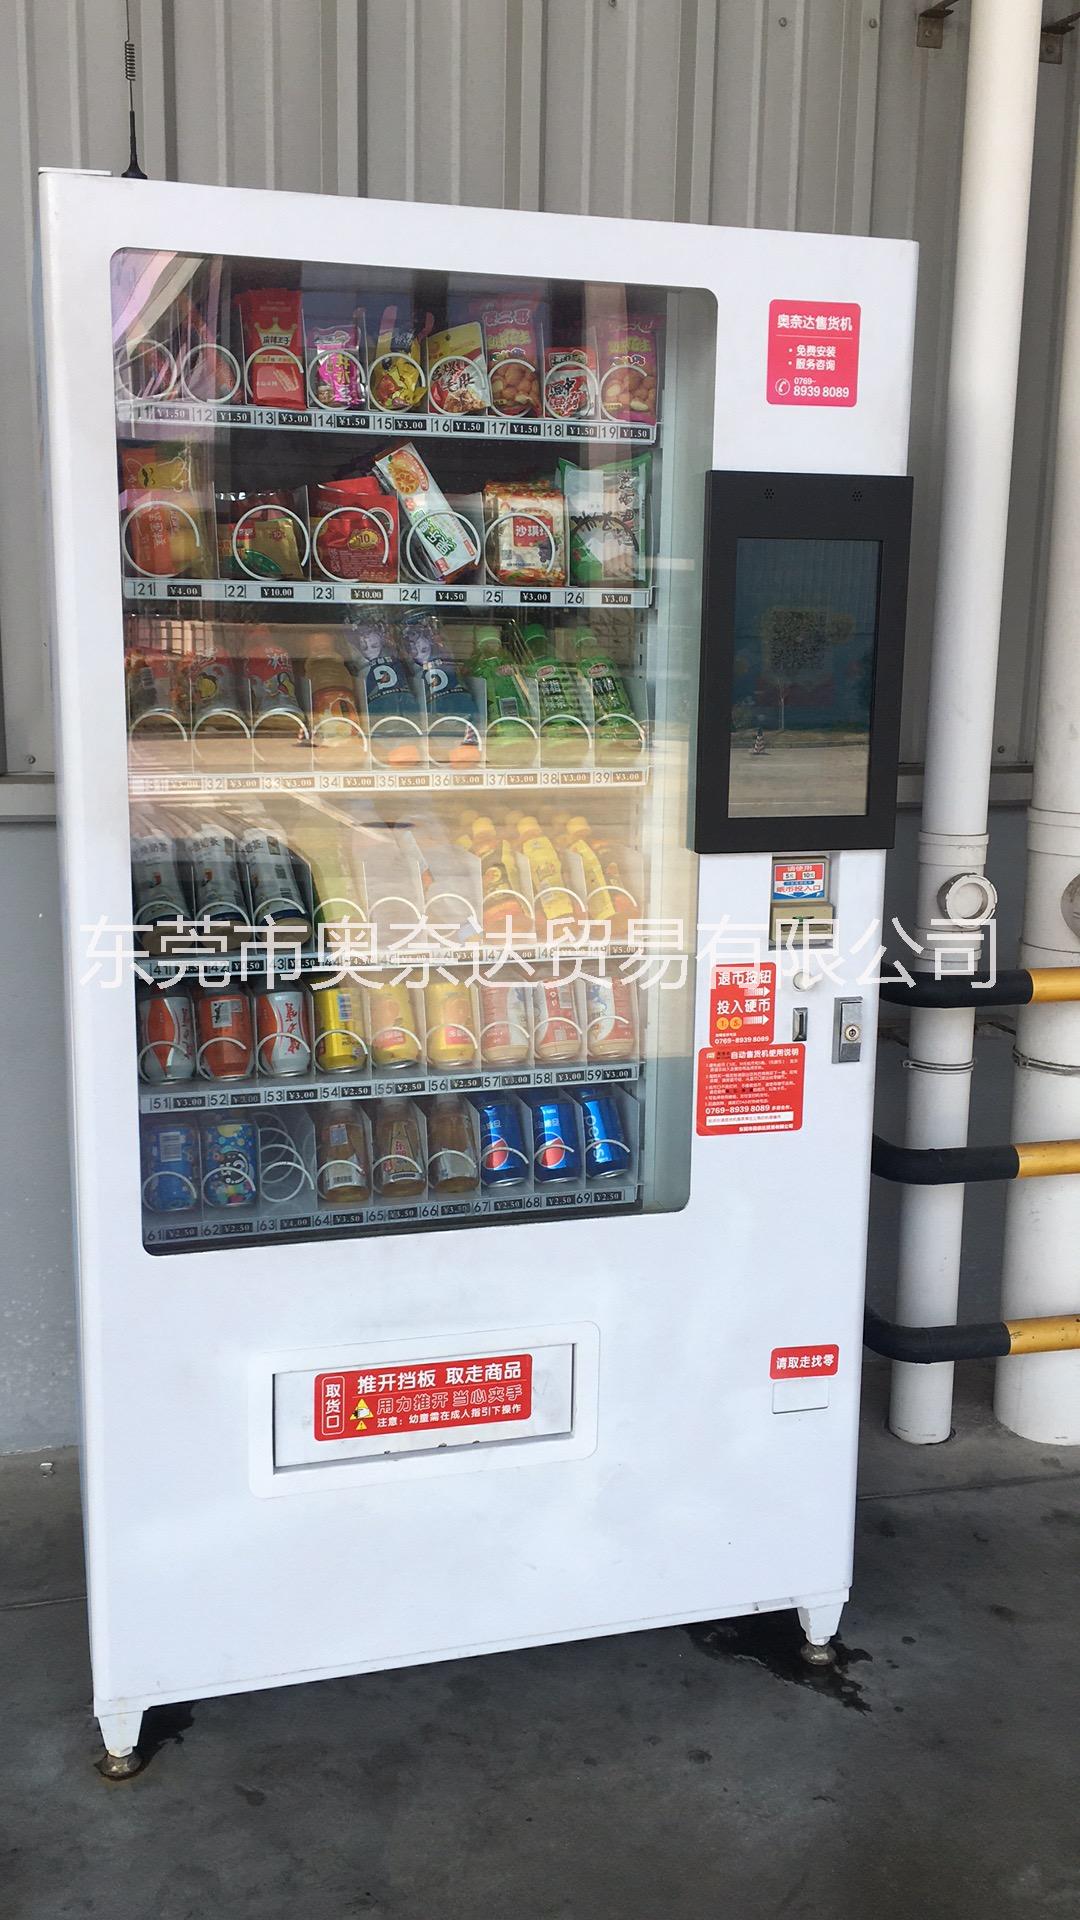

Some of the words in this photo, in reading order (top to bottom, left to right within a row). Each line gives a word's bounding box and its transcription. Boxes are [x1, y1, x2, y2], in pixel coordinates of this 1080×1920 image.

[778, 314, 852, 332] 奥奈达售货机
[796, 345, 836, 358] 免费安装
[796, 358, 836, 371] 服务咨询
[793, 386, 821, 396] 8939
[822, 387, 850, 398] 8089
[196, 408, 212, 421] 12
[220, 412, 248, 421] ¥1.50
[258, 412, 274, 424] 13
[282, 414, 308, 423] ¥3.00
[318, 414, 334, 426] 14
[339, 416, 366, 426] ¥1.50
[378, 417, 392, 430] 15
[398, 421, 423, 430] ¥3.00
[434, 420, 450, 432] 16
[456, 422, 480, 431] ¥1.50
[492, 422, 506, 435] 17
[512, 424, 538, 434] ¥1.50
[547, 425, 562, 437] 18
[570, 426, 594, 436] ¥1.50
[602, 426, 616, 438] 19
[622, 429, 648, 438] ¥1.50
[138, 582, 154, 596] 21
[170, 586, 198, 596] ¥4.00
[228, 584, 245, 597] 22
[264, 587, 292, 597] ¥10.00
[316, 586, 332, 599] 23
[354, 589, 382, 599] ¥10.00
[402, 589, 418, 601] 24
[438, 592, 464, 601] ¥4.50
[486, 590, 500, 602] 25
[523, 592, 548, 602] ¥3.00
[568, 591, 583, 604] 26
[605, 594, 628, 604] ¥3.00
[206, 777, 223, 790] 32
[322, 776, 338, 788] 34
[380, 775, 395, 787] 35
[434, 774, 449, 787] 36
[488, 774, 504, 786] 37
[542, 772, 558, 785] 38
[595, 772, 610, 784] 39
[234, 962, 260, 970] ¥.50
[290, 958, 315, 968] ¥.50
[716, 998, 770, 1014] 投入硬币
[153, 1098, 169, 1109] 51
[176, 1098, 202, 1107] ¥3.00
[210, 1094, 227, 1106] 52
[266, 1089, 283, 1102] 53
[289, 1090, 315, 1099] ¥3.00
[322, 1086, 338, 1098] 54
[344, 1086, 369, 1096] ¥2.50
[378, 1083, 392, 1096] 55
[398, 1084, 422, 1092] ¥2.50
[431, 1080, 446, 1092] 56
[454, 1080, 477, 1088] ¥2.50
[484, 1076, 499, 1088] 57
[536, 1073, 551, 1084] 58
[559, 1072, 582, 1081] ¥3.00
[587, 1070, 602, 1081] 59
[605, 1070, 628, 1078] ¥3.00
[706, 1106, 750, 1114] 0769-8939
[750, 1104, 770, 1112] 8089
[147, 1229, 164, 1242] 61
[204, 1223, 219, 1236] 62
[259, 1218, 275, 1231] 63
[314, 1214, 330, 1226] 64
[368, 1209, 384, 1222] 65
[422, 1204, 437, 1217] 66
[474, 1201, 489, 1213] 67
[526, 1197, 540, 1208] 68
[576, 1192, 590, 1204] 69
[776, 1354, 834, 1370] 请取走找零
[358, 1370, 436, 1394] 推开挡板
[446, 1361, 521, 1385] 取走商品
[326, 1384, 340, 1428] 取货口
[376, 1392, 448, 1414] 用力推开
[452, 1384, 522, 1408] 当心夹手
